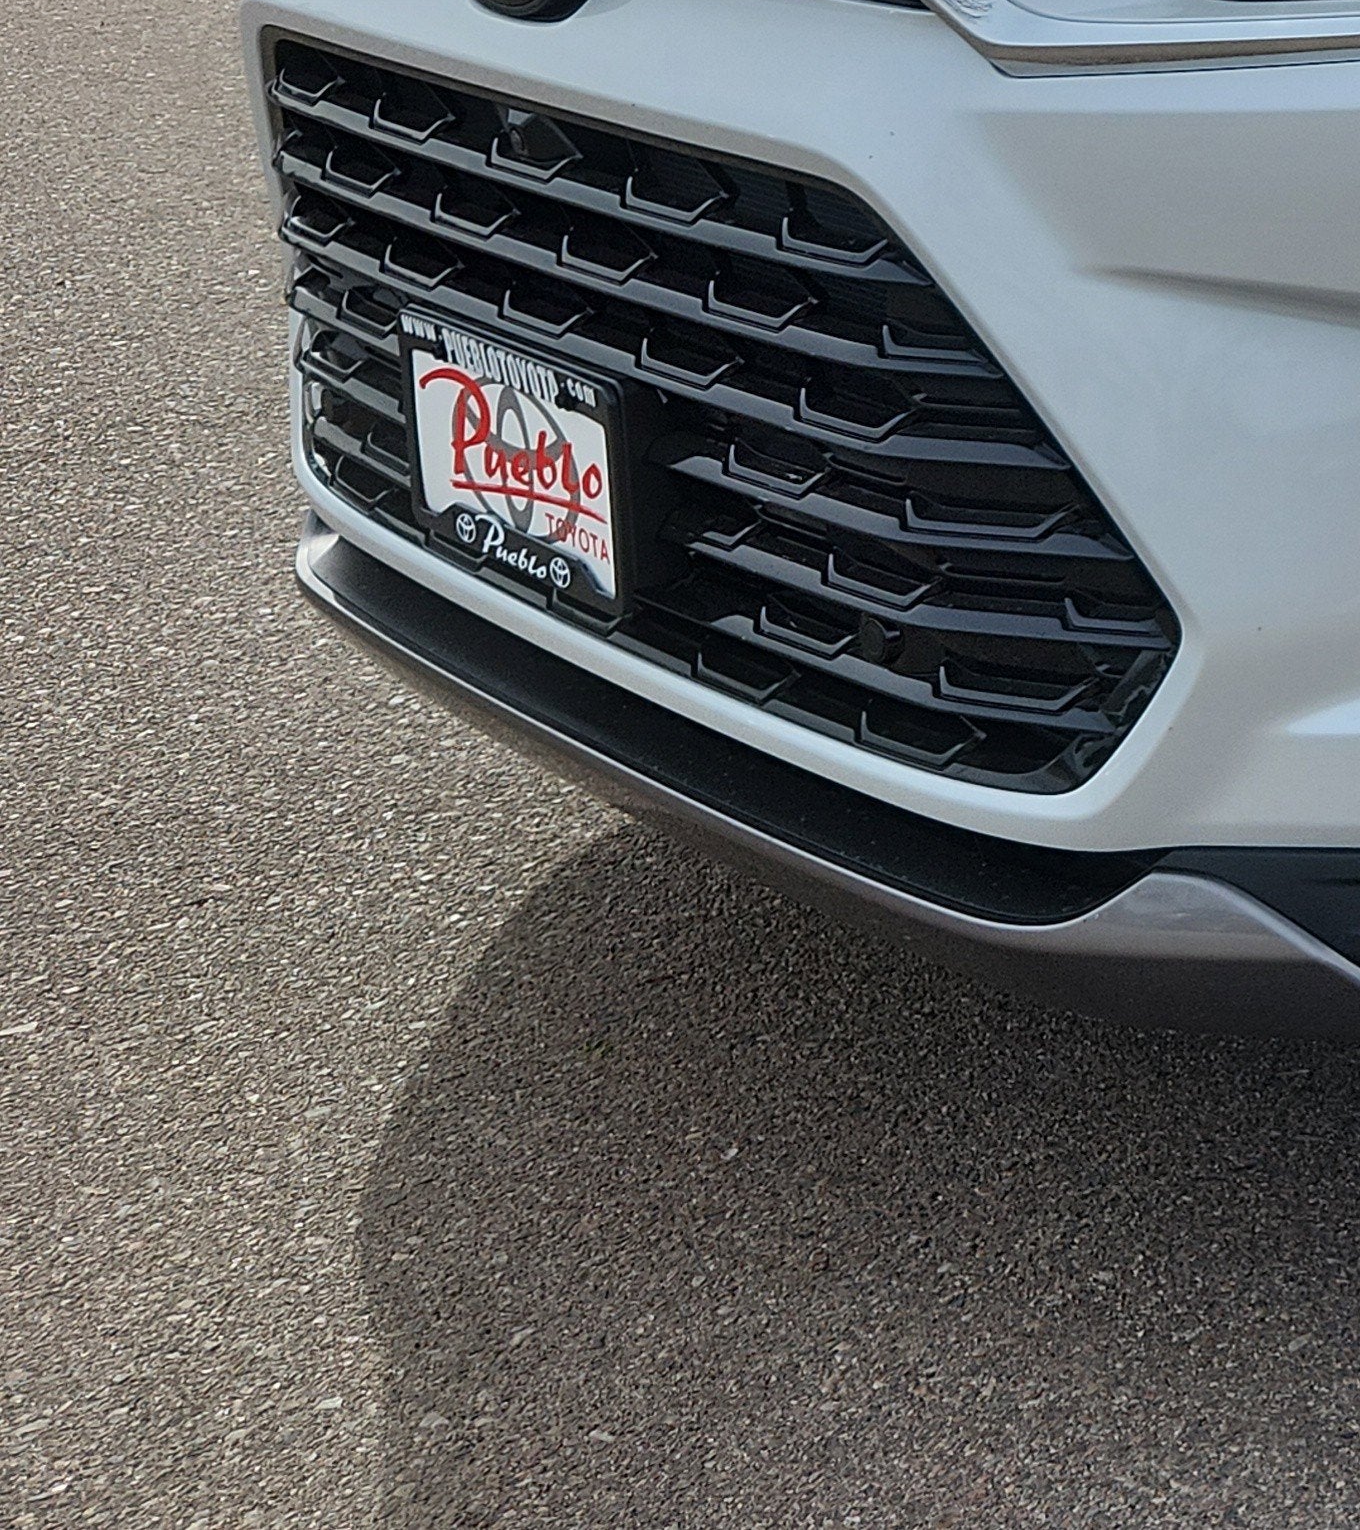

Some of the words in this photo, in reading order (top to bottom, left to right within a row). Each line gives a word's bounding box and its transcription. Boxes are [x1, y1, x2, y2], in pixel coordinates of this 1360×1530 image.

[418, 367, 602, 500] Pueblo
[475, 513, 548, 579] Pueblo
[545, 512, 611, 565] TOYOTA
